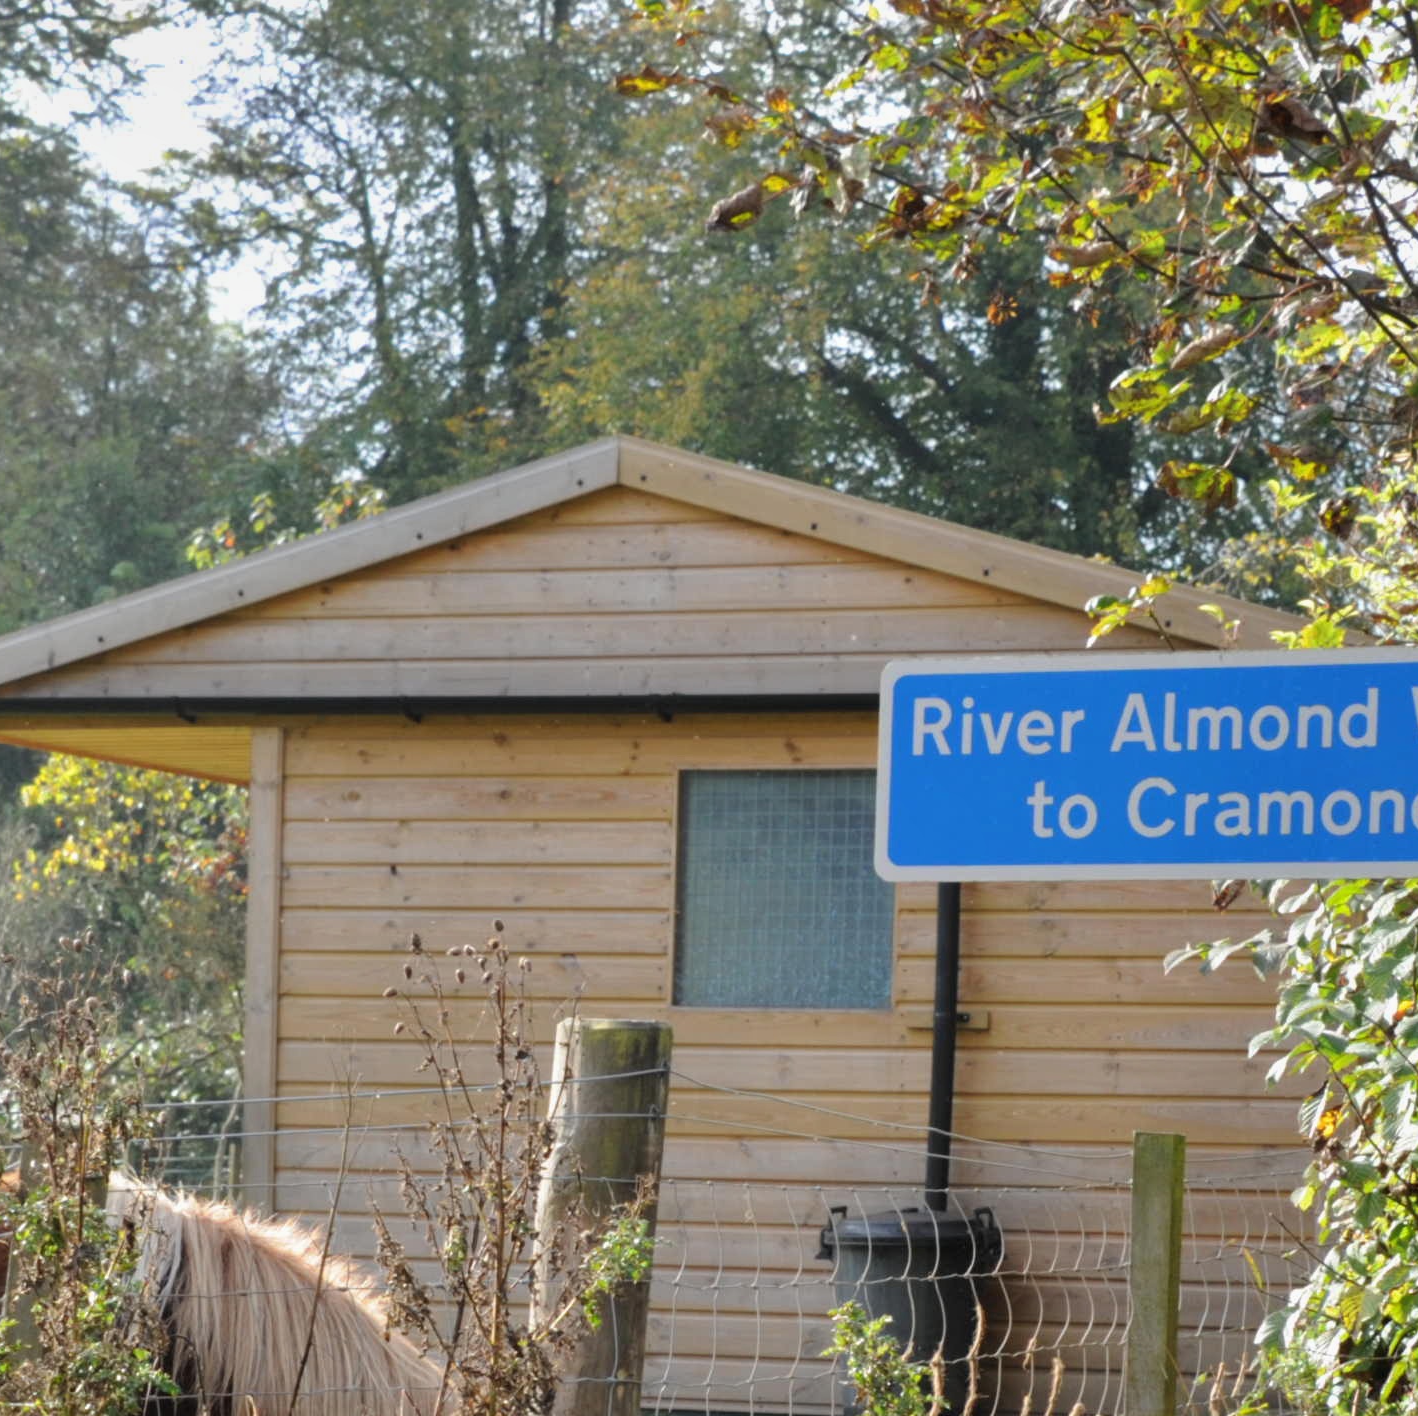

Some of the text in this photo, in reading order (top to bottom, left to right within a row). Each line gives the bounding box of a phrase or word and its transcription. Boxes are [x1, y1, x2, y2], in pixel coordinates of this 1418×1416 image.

[912, 696, 1086, 756] River
[1110, 687, 1379, 753] Almond
[1027, 781, 1098, 839] to
